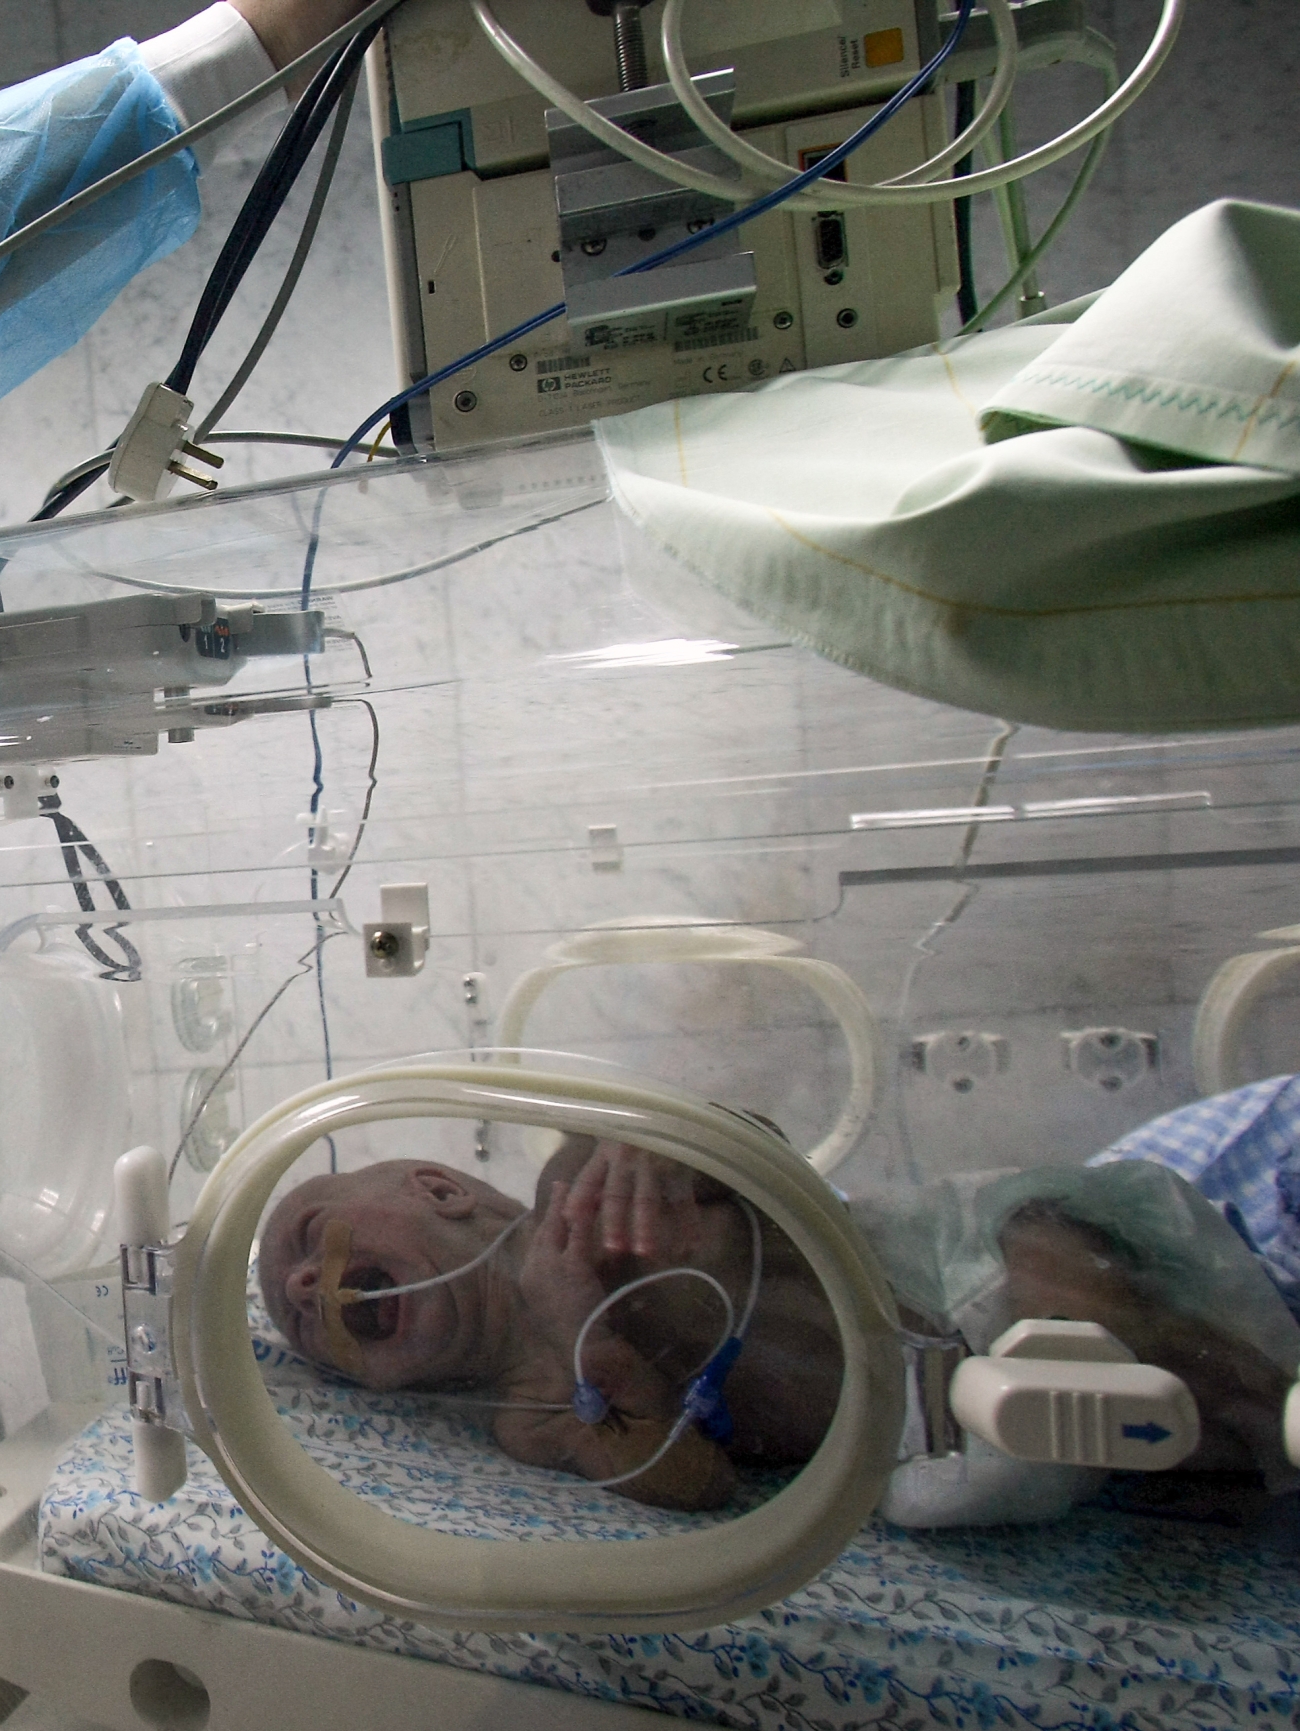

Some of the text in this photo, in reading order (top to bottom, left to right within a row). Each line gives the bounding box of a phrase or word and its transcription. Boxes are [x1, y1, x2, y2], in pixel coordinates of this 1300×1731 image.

[838, 36, 850, 78] Silence/
[850, 39, 861, 69] Reset
[564, 367, 611, 382] HEWLETT
[564, 376, 613, 389] PACKARD
[203, 634, 226, 653] 1 2
